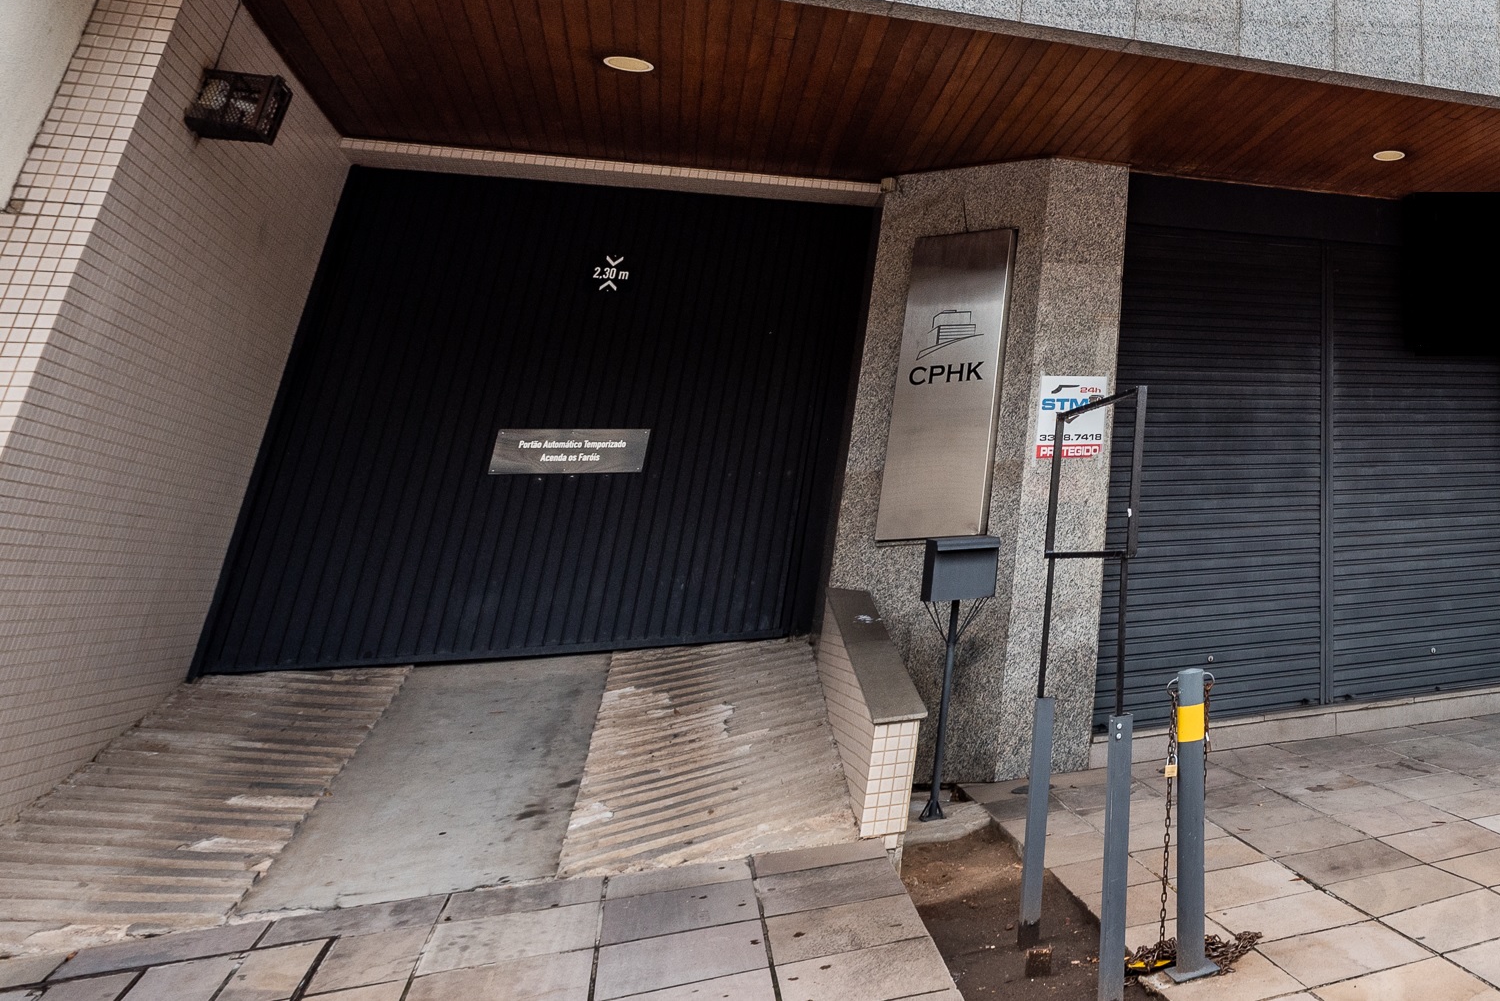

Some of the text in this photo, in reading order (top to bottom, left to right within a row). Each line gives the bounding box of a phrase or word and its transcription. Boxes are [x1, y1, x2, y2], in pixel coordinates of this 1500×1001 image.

[618, 271, 629, 280] m
[909, 361, 984, 385] CPHK
[1039, 433, 1102, 442] 338.7418
[518, 440, 627, 450] Portão Automático Temporizado
[1040, 445, 1100, 457] PRTEGIDO
[540, 453, 566, 462] Acenda
[578, 453, 600, 461] Faróis
